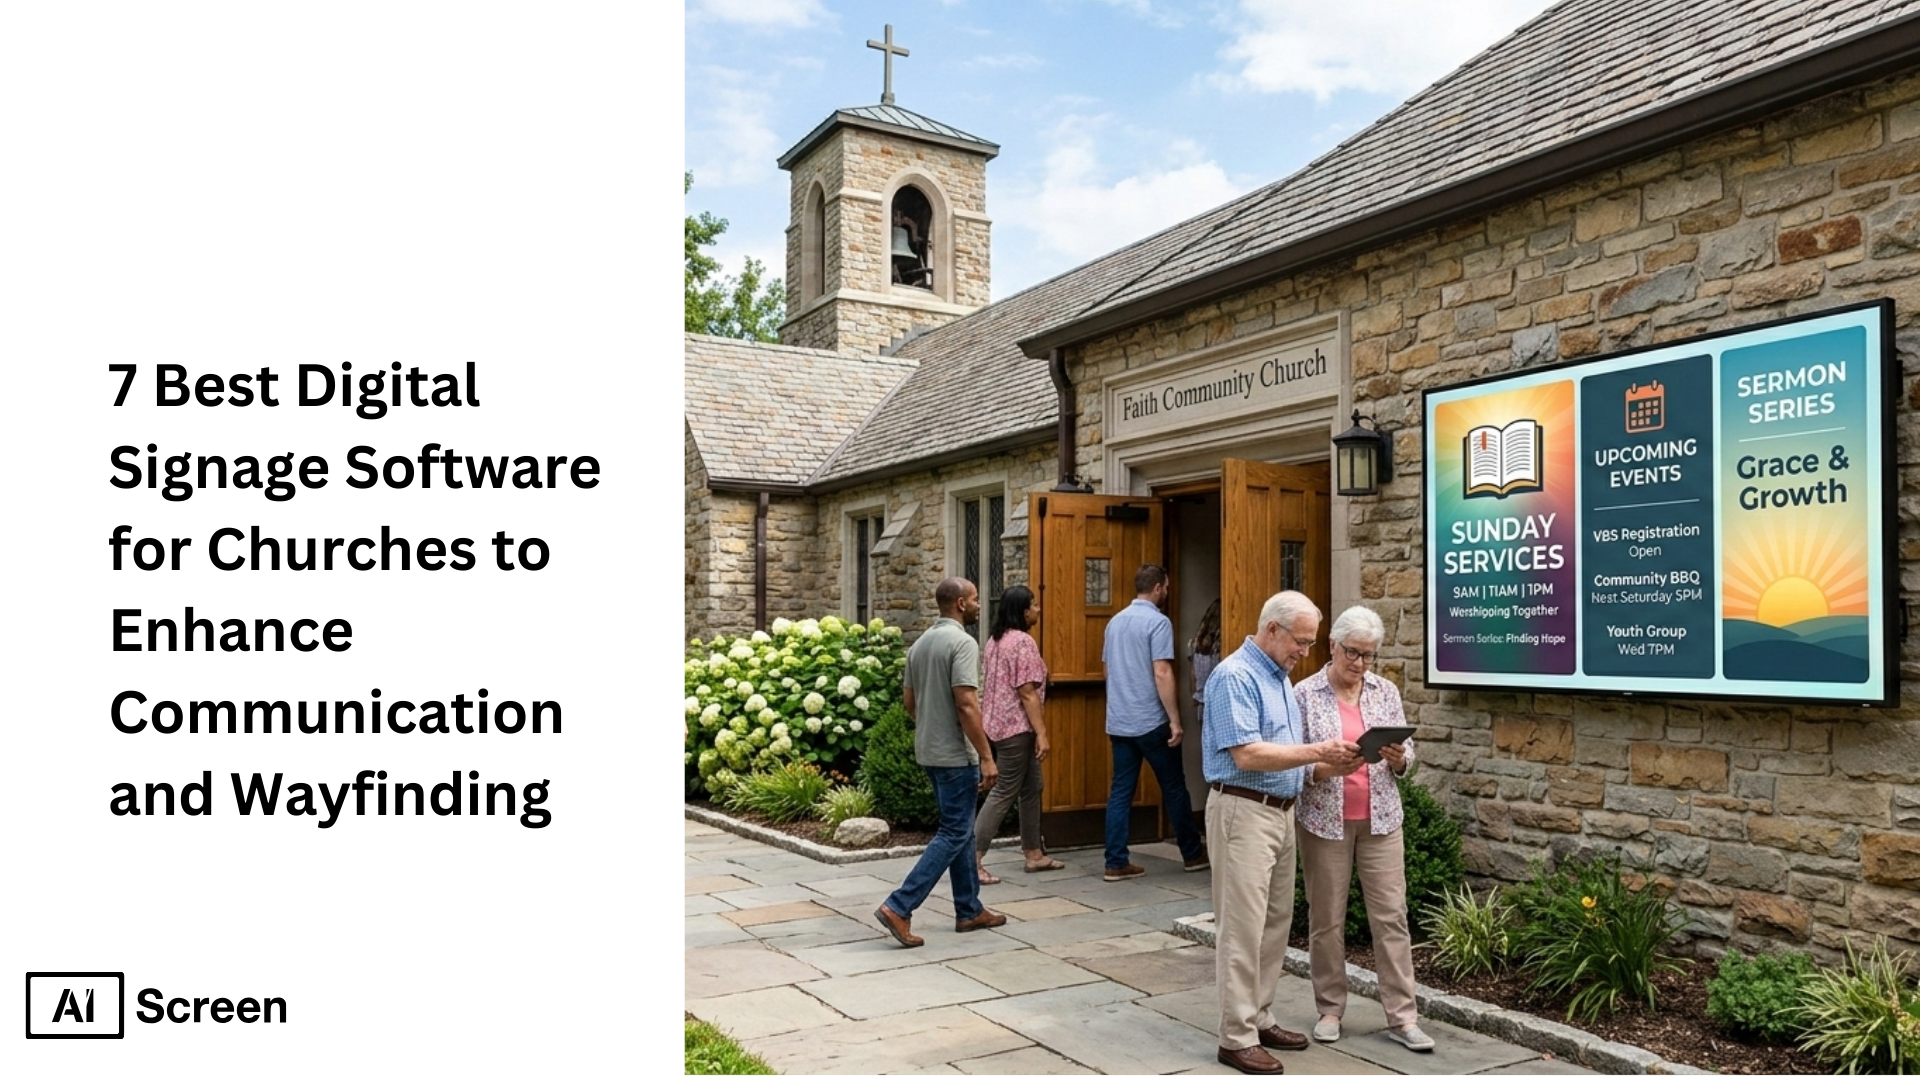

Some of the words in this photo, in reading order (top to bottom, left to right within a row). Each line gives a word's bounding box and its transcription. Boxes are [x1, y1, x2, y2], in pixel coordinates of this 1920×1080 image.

[1123, 391, 1159, 421] Faith
[1162, 369, 1255, 411] Community
[1260, 347, 1327, 387] Church
[1737, 360, 1847, 397] SERMON
[1748, 392, 1836, 424] SERIES
[1595, 438, 1697, 467] UPCOMING
[1736, 453, 1820, 480] Grace
[1828, 444, 1850, 471] &
[1610, 464, 1682, 488] EVENTS
[1739, 477, 1847, 511] Growth
[1451, 512, 1556, 545] SUNDAY
[1593, 529, 1618, 543] VBS
[1621, 523, 1700, 543] Registration
[1443, 544, 1565, 575] SERVICES
[1628, 545, 1662, 560] Open
[1594, 571, 1667, 587] Community
[1670, 570, 1700, 585] BBQ
[1606, 624, 1644, 638] Youth
[1646, 625, 1687, 640] Group
[1617, 643, 1645, 656] Wed
[1647, 643, 1675, 656] 7PM
